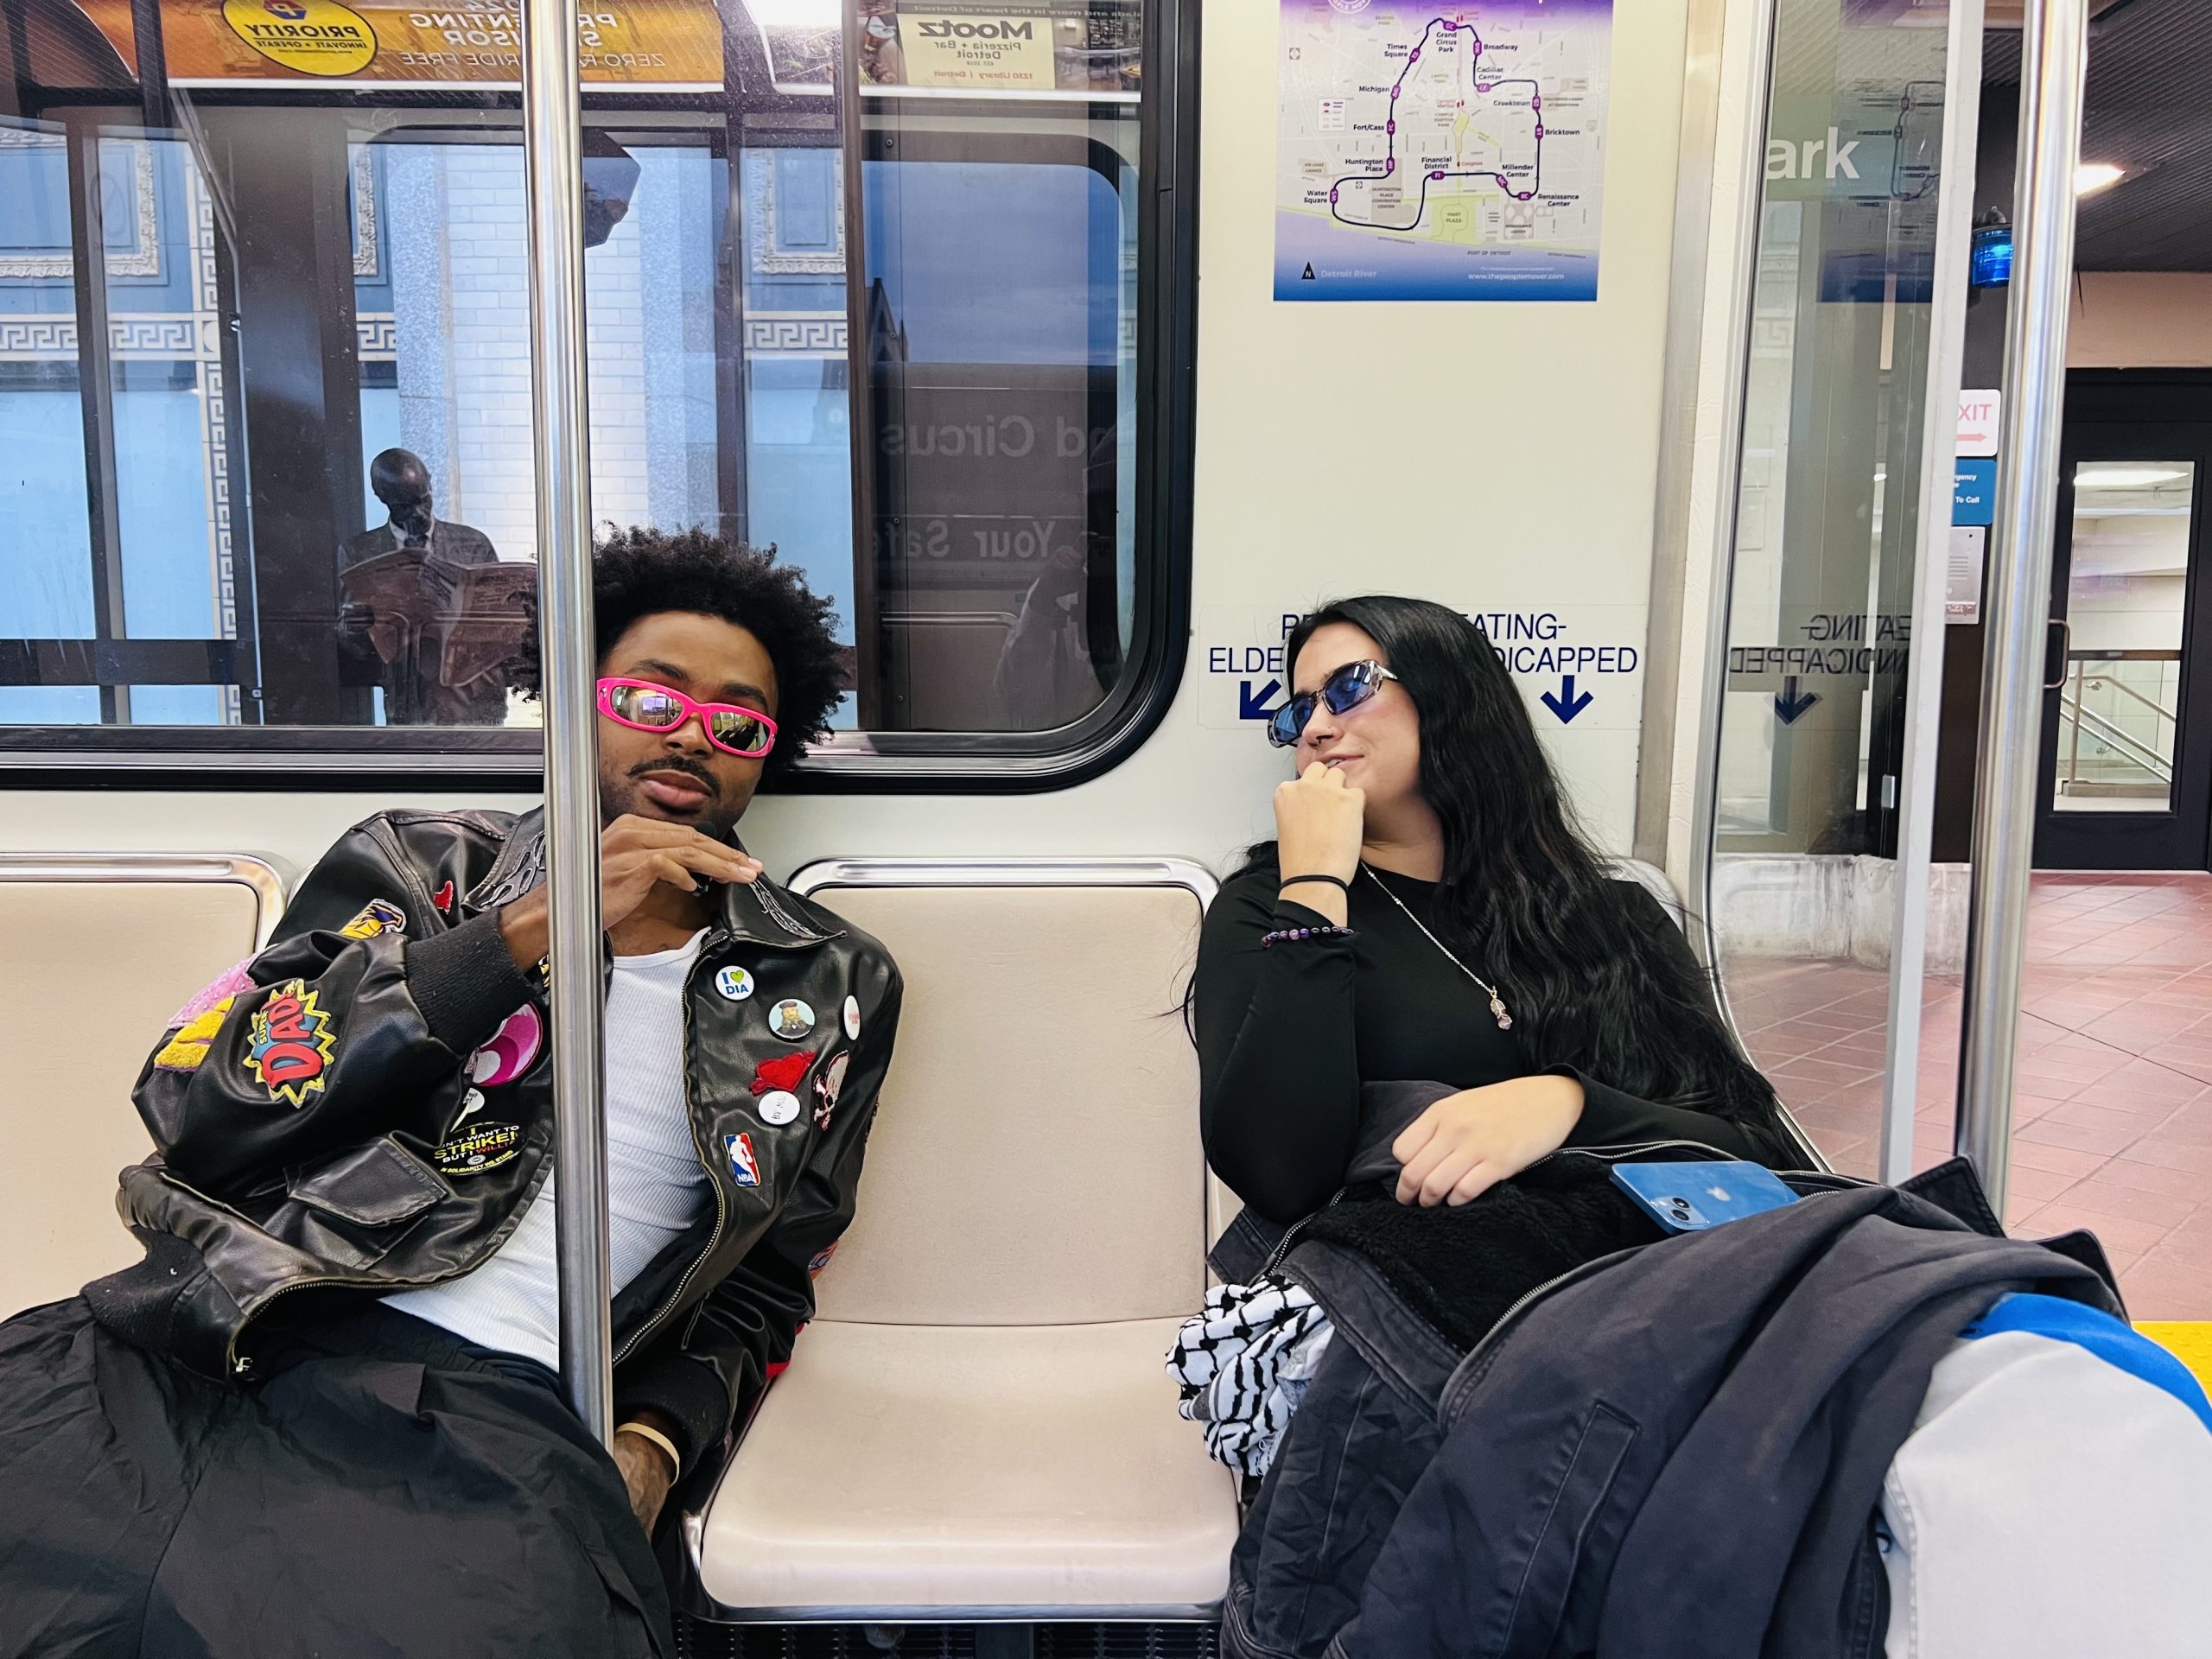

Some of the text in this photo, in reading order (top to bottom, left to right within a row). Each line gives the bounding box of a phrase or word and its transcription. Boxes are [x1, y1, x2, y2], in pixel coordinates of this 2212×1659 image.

[1767, 127, 1859, 179] ark
[1344, 158, 1383, 167] Huntington
[1320, 270, 1377, 278] Detroit River
[1958, 403, 1992, 421] XIT
[1473, 613, 1567, 640] ATING-
[1210, 647, 1284, 673] ELDE
[726, 984, 749, 995] DIA
[467, 1129, 501, 1141] WANT
[434, 1131, 517, 1159] STRIKE!
[442, 1152, 467, 1163] BUT
[737, 1173, 754, 1183] NBA
